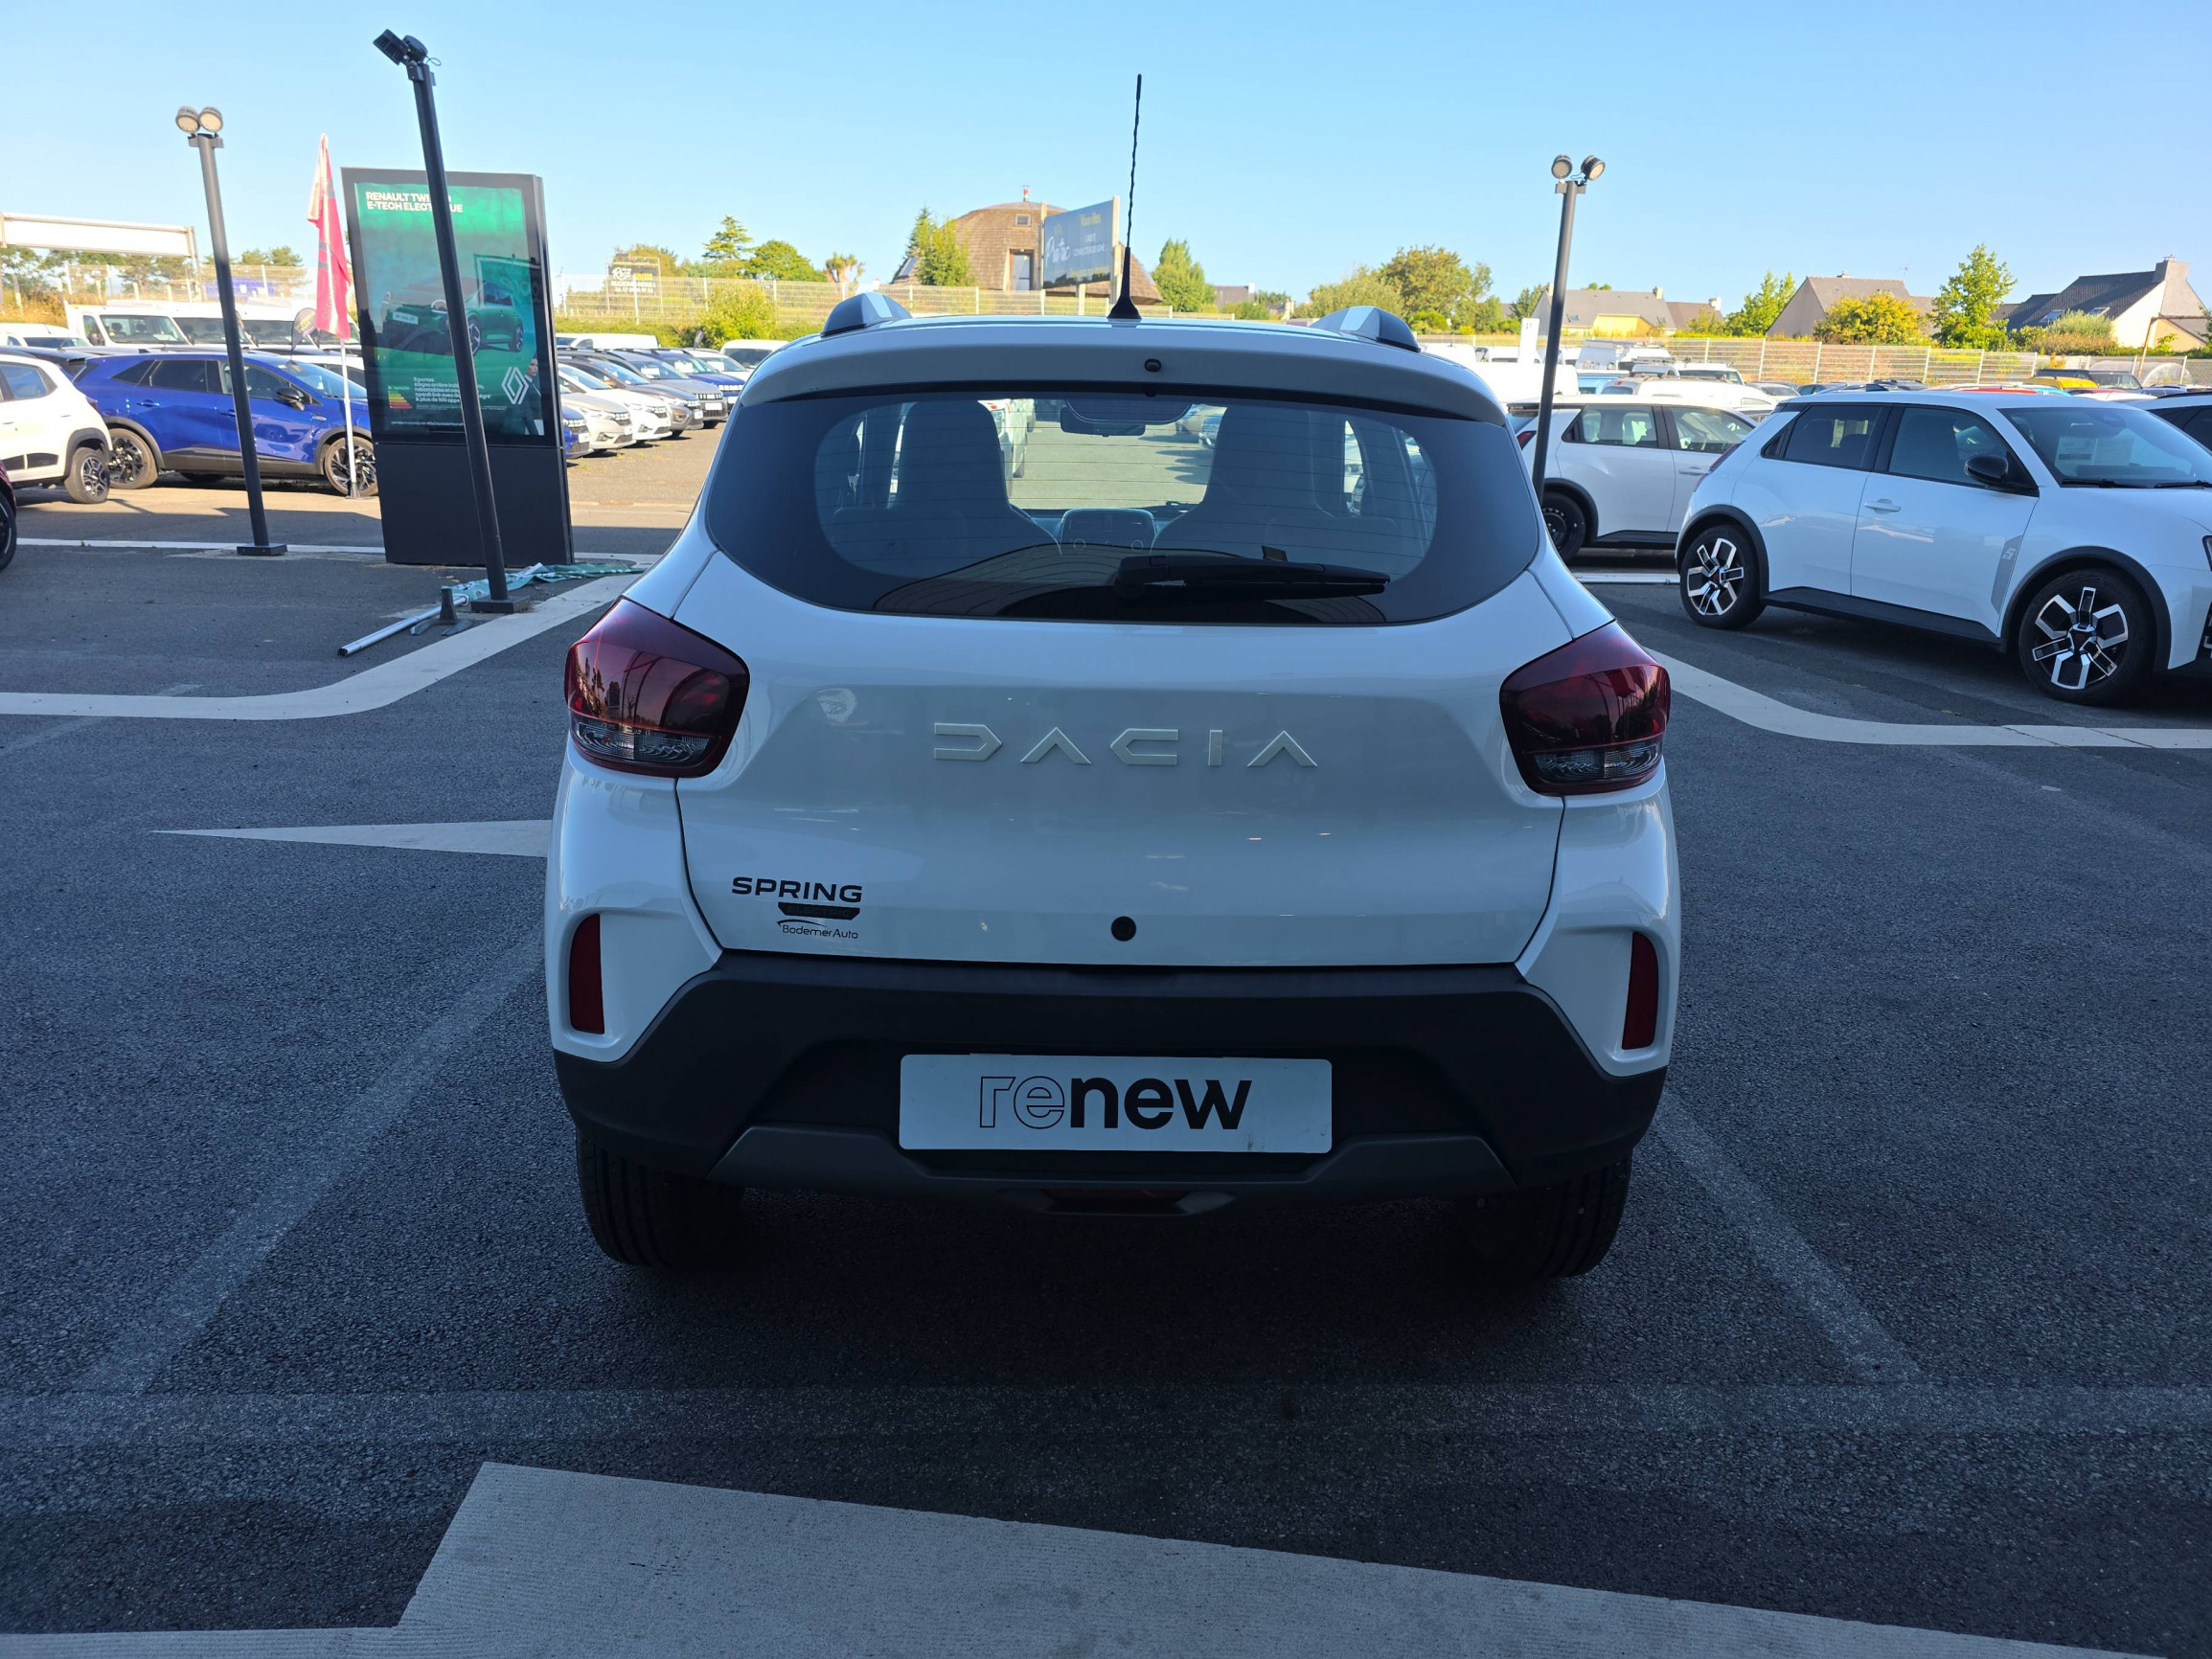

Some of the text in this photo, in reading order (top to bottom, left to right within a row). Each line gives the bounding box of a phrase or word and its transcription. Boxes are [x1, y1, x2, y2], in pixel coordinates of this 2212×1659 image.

[366, 192, 409, 202] RENAULT
[367, 200, 464, 213] E-TECH ELECTUE
[934, 722, 1318, 767] DACIA
[732, 876, 862, 903] SPRING
[979, 1076, 1252, 1130] renew
